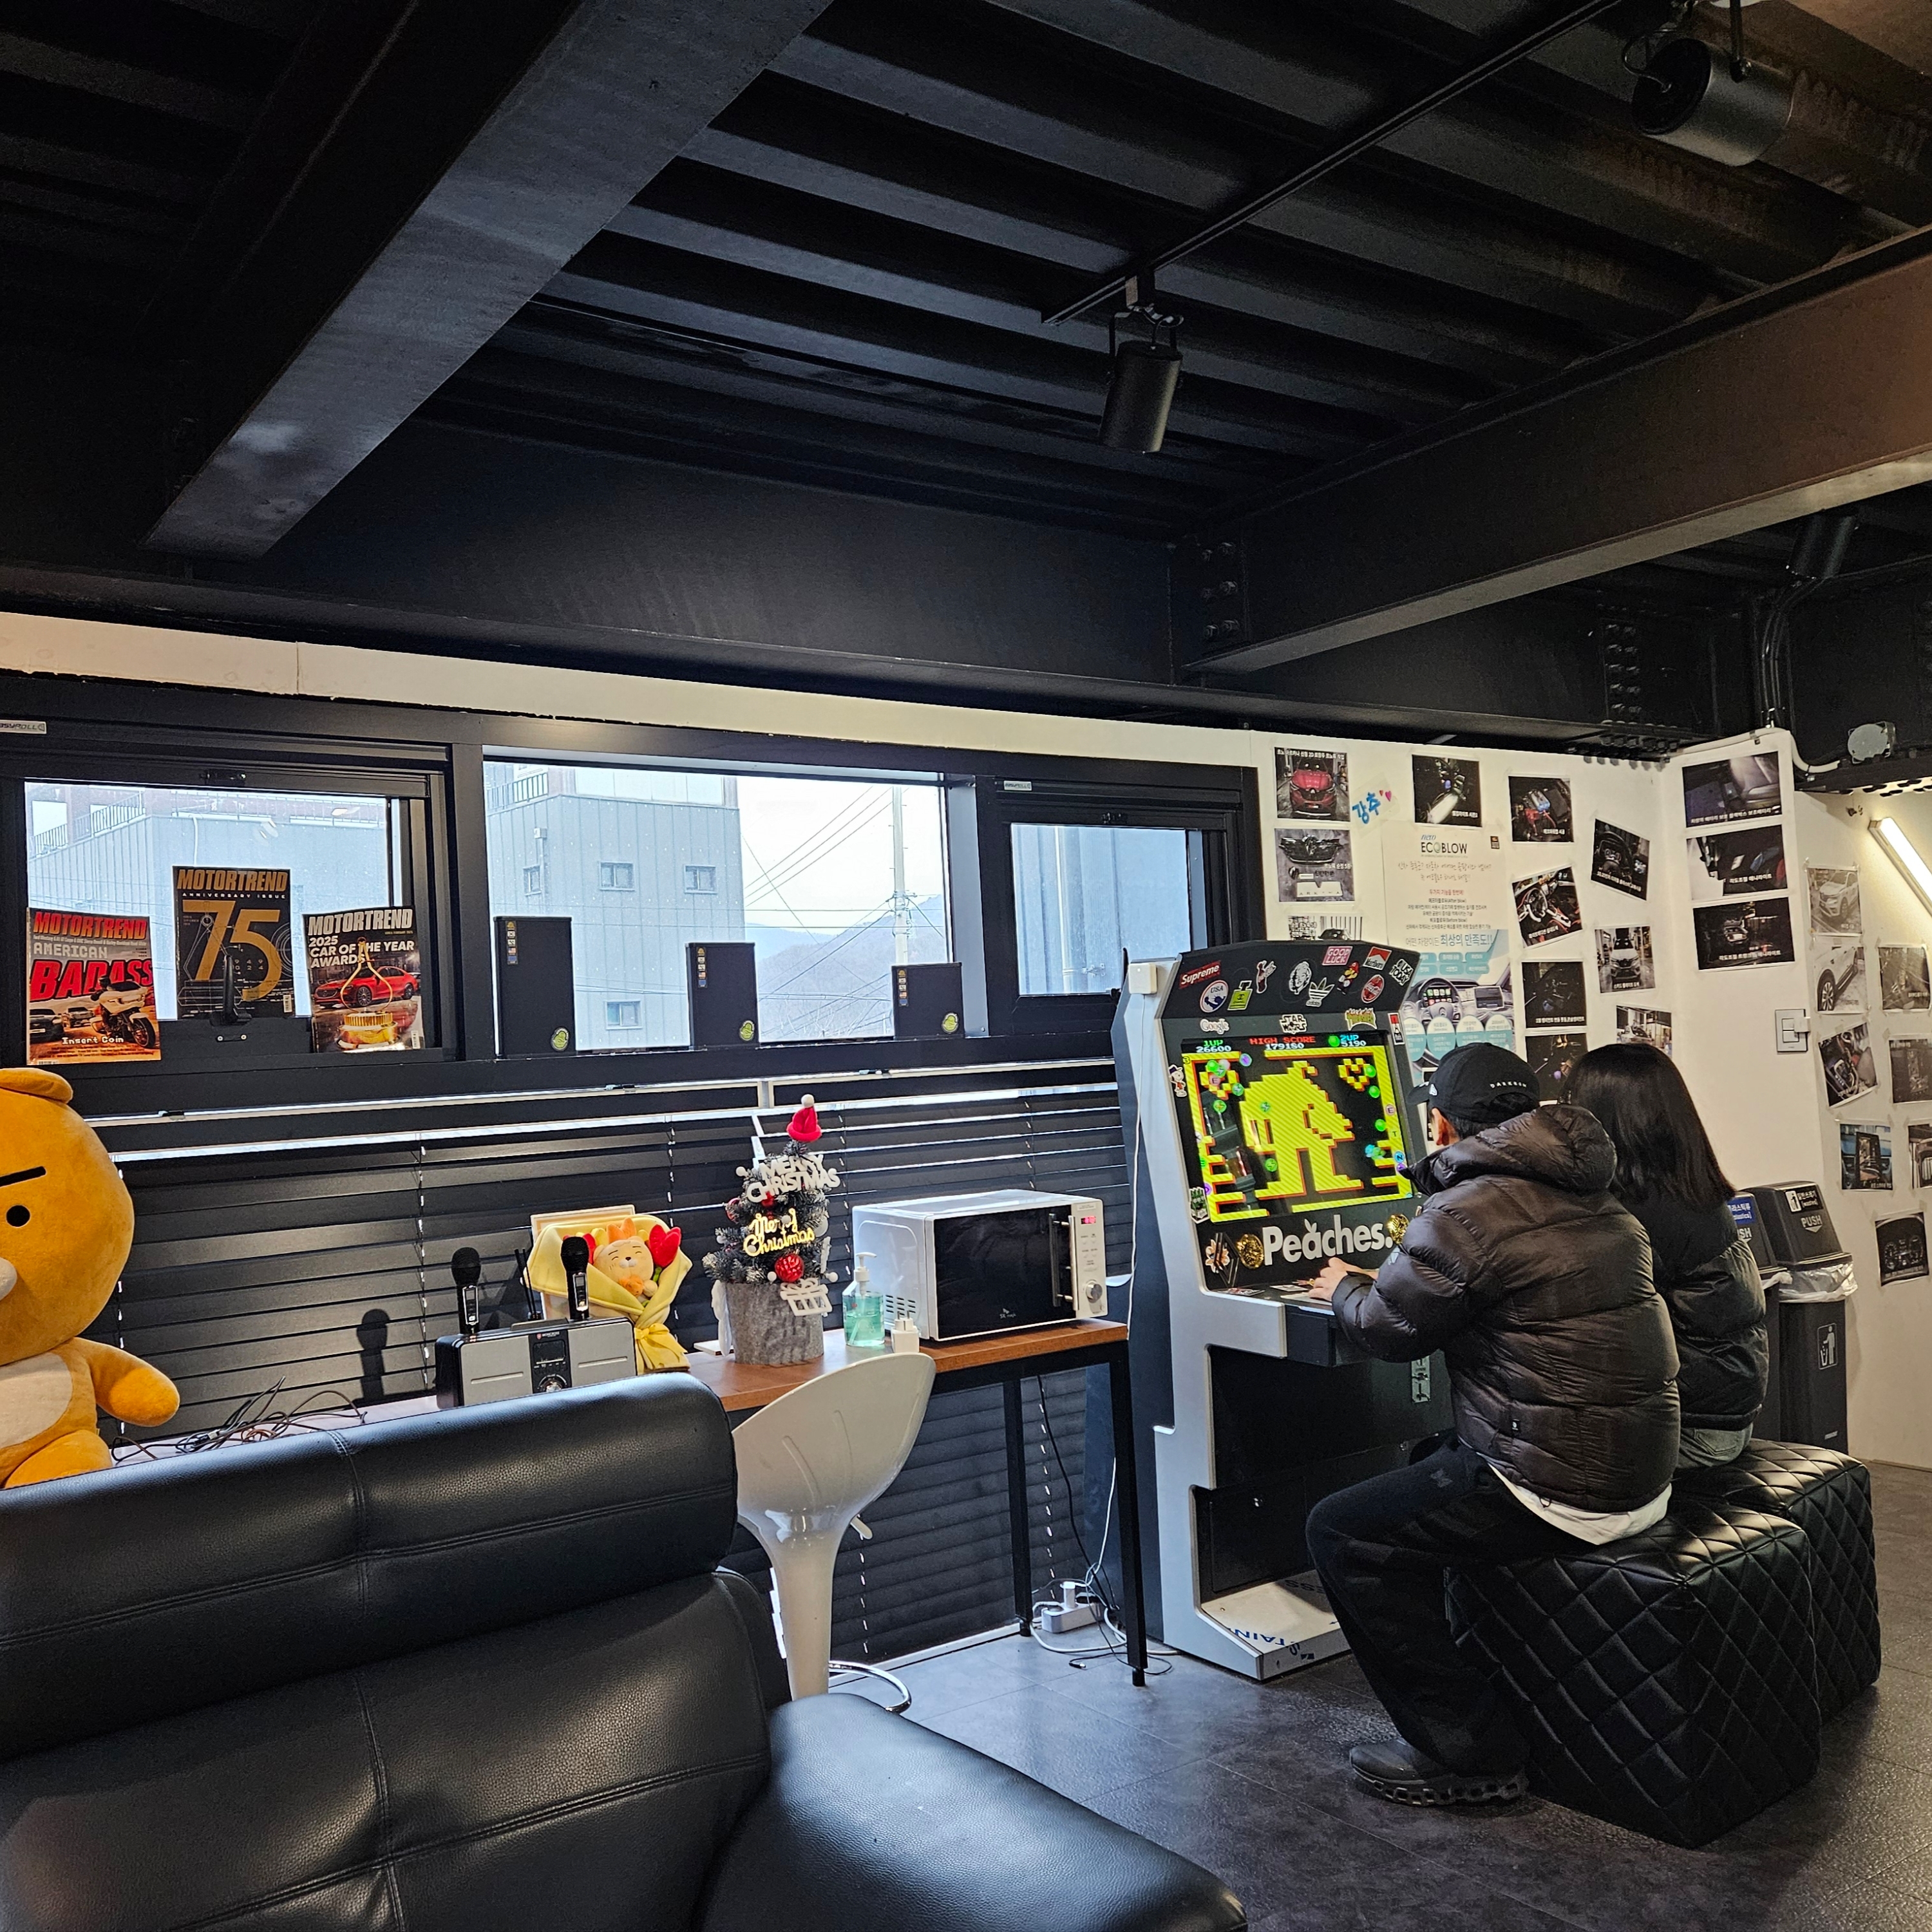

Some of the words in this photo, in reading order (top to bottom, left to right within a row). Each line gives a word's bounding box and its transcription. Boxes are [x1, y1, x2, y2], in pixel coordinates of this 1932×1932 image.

[1352, 791, 1381, 824] 강추
[1421, 842, 1468, 854] ECOBLOW
[177, 869, 288, 892] MOTORTREND
[33, 912, 147, 940] MOTORTREND
[308, 909, 413, 935] MOTORTREND
[308, 936, 338, 947] 2025
[1441, 934, 1463, 947] 최상의
[33, 942, 108, 959] AMERICAN
[182, 900, 281, 1001] 75
[310, 946, 336, 958] CAR
[339, 943, 355, 954] OF
[383, 941, 414, 951] YEAR
[1327, 948, 1350, 956] GOOD
[310, 954, 365, 969] AWARDS
[1401, 963, 1414, 975] USA
[30, 960, 153, 1003] BADASS
[1181, 965, 1220, 985] Supreme
[1390, 967, 1410, 984] TODAY
[1201, 1019, 1229, 1034] Google
[1283, 1022, 1307, 1031] WARS
[747, 1168, 840, 1203] CHRISTMAS
[1801, 1215, 1823, 1227] PUSH
[743, 1227, 815, 1257] Christmas
[1262, 1215, 1393, 1266] Peaches.
